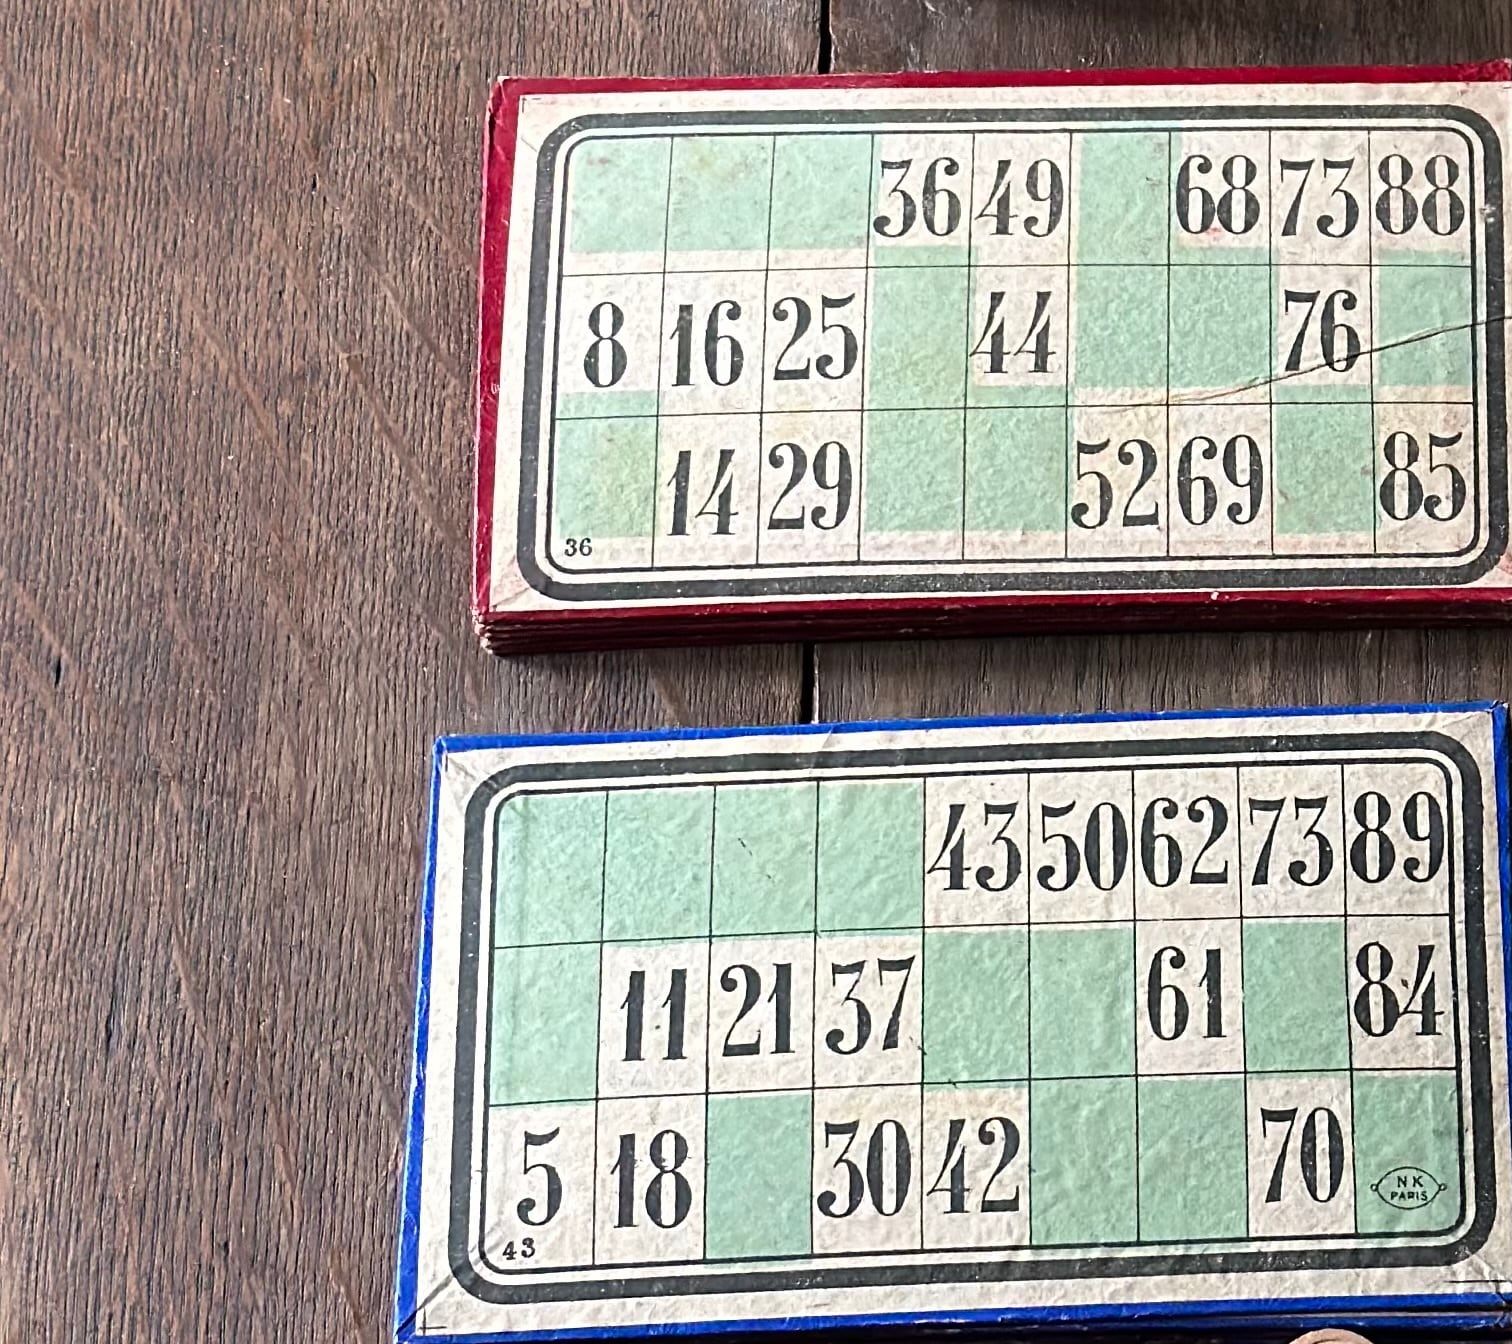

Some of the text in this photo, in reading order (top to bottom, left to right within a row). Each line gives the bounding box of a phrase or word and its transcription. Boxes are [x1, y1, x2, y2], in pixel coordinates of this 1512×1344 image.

[873, 154, 1465, 238] 36 49 68 73 88
[584, 289, 1363, 388] 8 16 25 44 76
[667, 431, 1466, 536] 14 29 52 69 85
[565, 538, 592, 557] 36
[927, 791, 1444, 892] 43 50 62 73 89
[621, 941, 1444, 1061] 11 21 37 61 84
[517, 1107, 1344, 1228] 5 18 30 42 70
[1390, 1191, 1428, 1202] PARIS
[503, 1238, 535, 1260] 43
